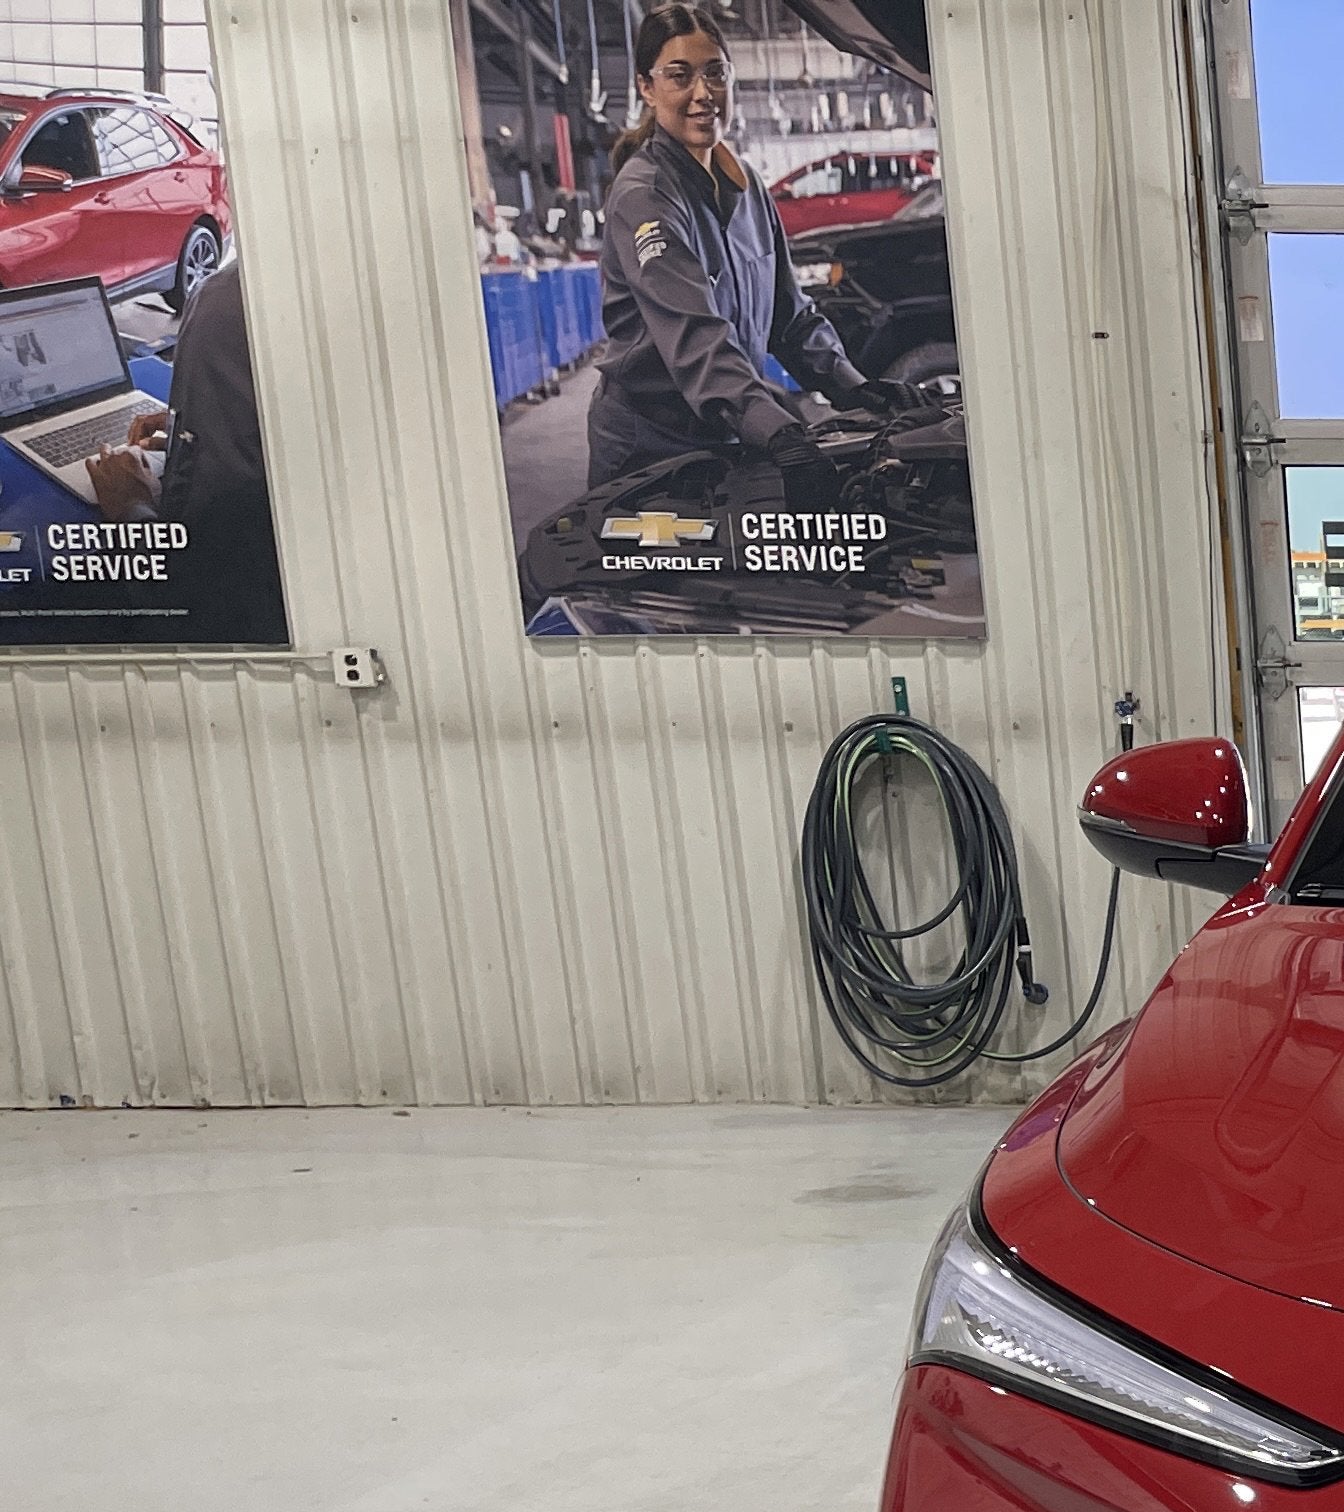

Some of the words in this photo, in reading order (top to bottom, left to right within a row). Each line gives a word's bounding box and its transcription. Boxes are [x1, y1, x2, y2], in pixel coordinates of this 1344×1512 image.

[47, 523, 188, 550] CERTIFIED
[741, 512, 887, 541] CERTIFIED
[51, 554, 169, 581] SERVICE
[601, 555, 724, 571] CHEVROLET
[744, 545, 866, 573] SERVICE
